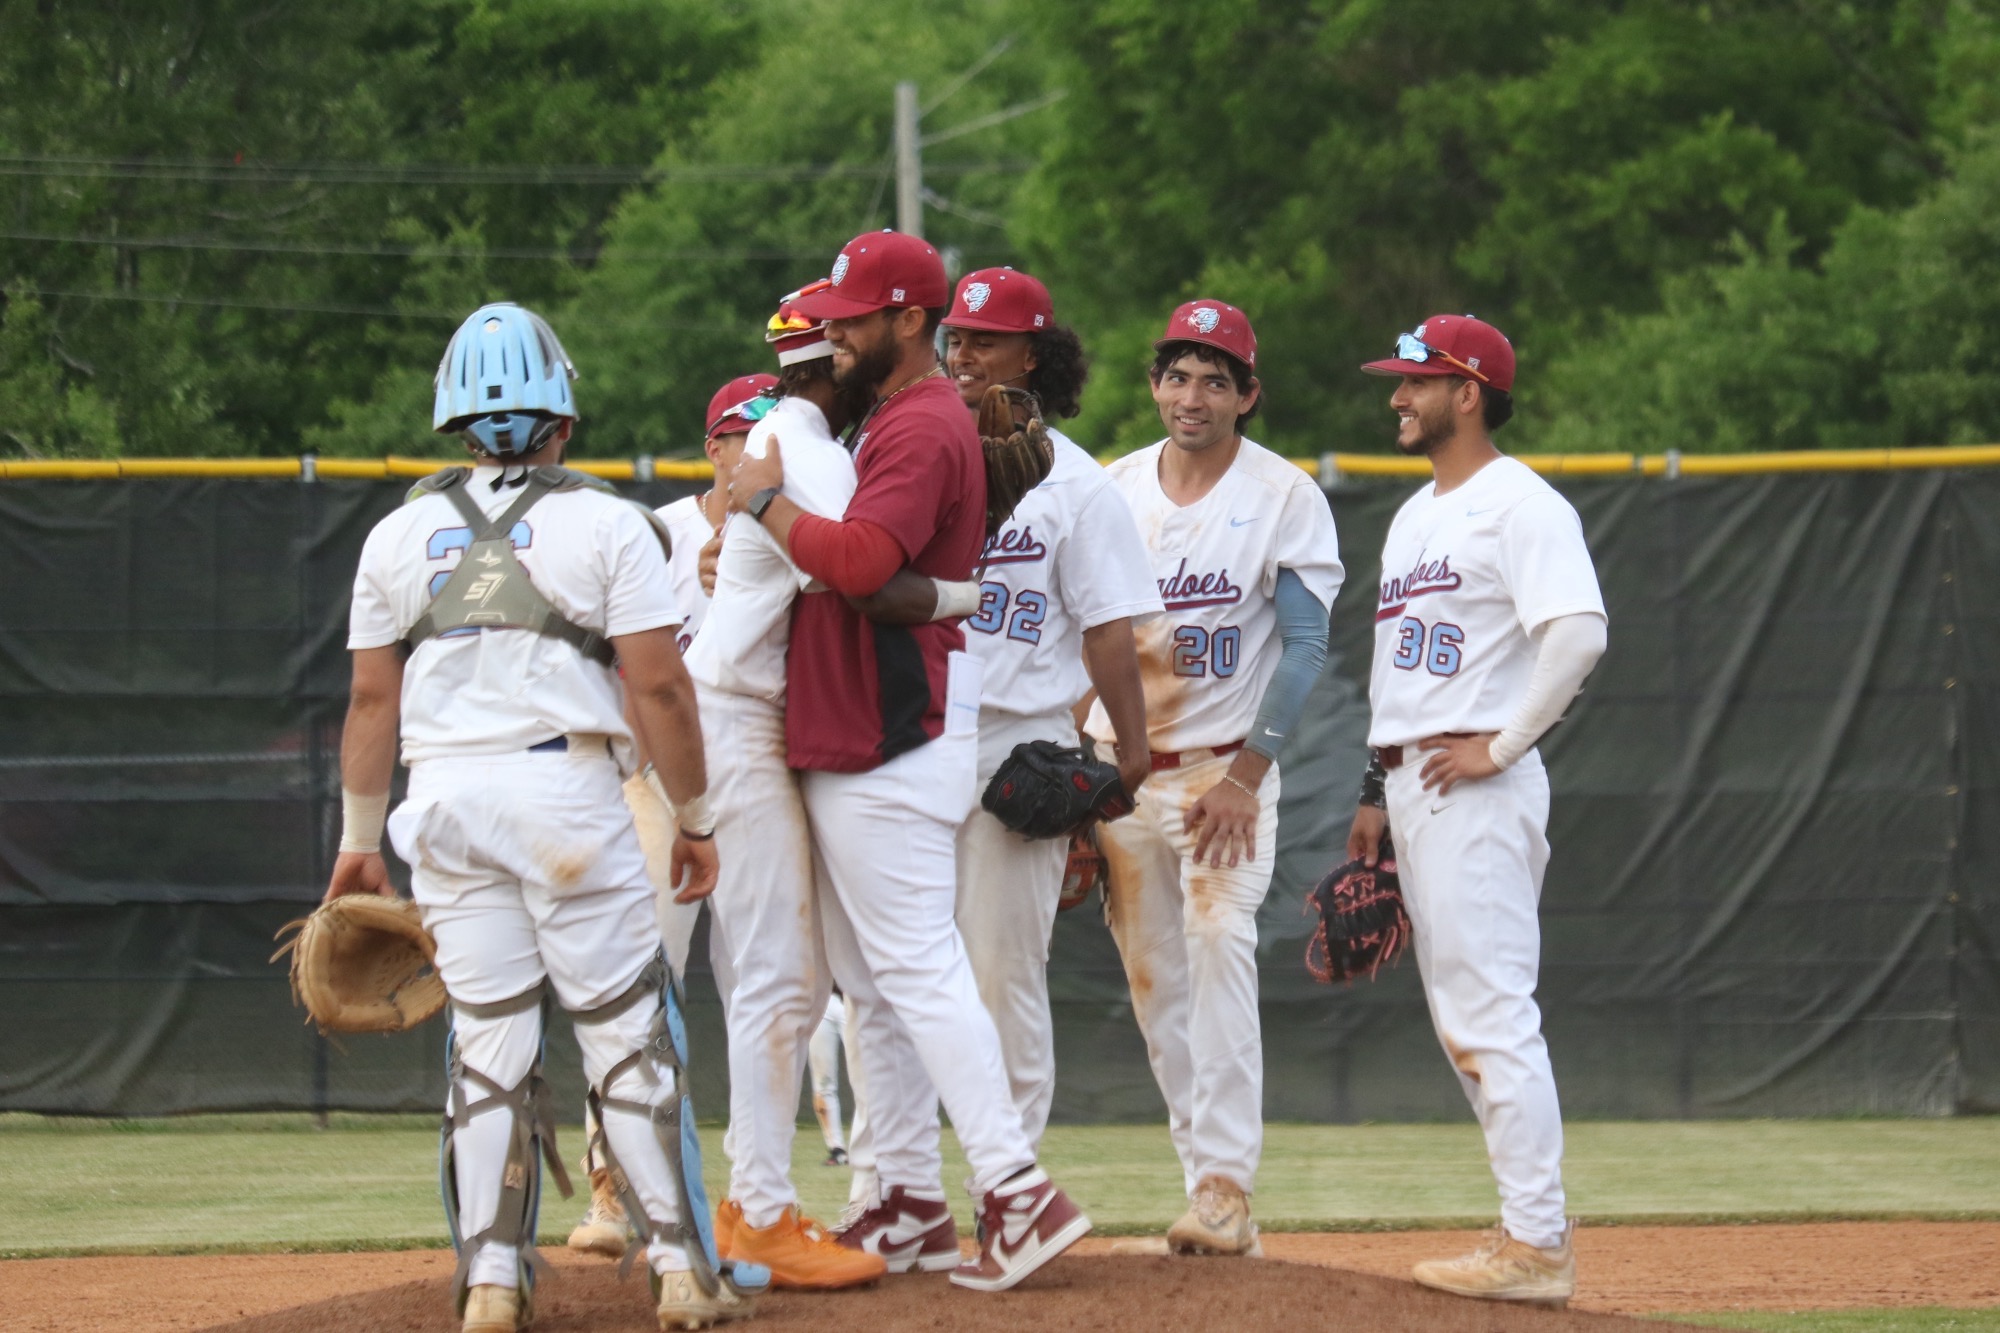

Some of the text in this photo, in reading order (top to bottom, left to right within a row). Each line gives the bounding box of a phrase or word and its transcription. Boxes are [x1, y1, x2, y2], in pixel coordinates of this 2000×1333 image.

[966, 580, 1048, 648] 32
[1172, 624, 1242, 680] 20
[1393, 615, 1465, 679] 36
